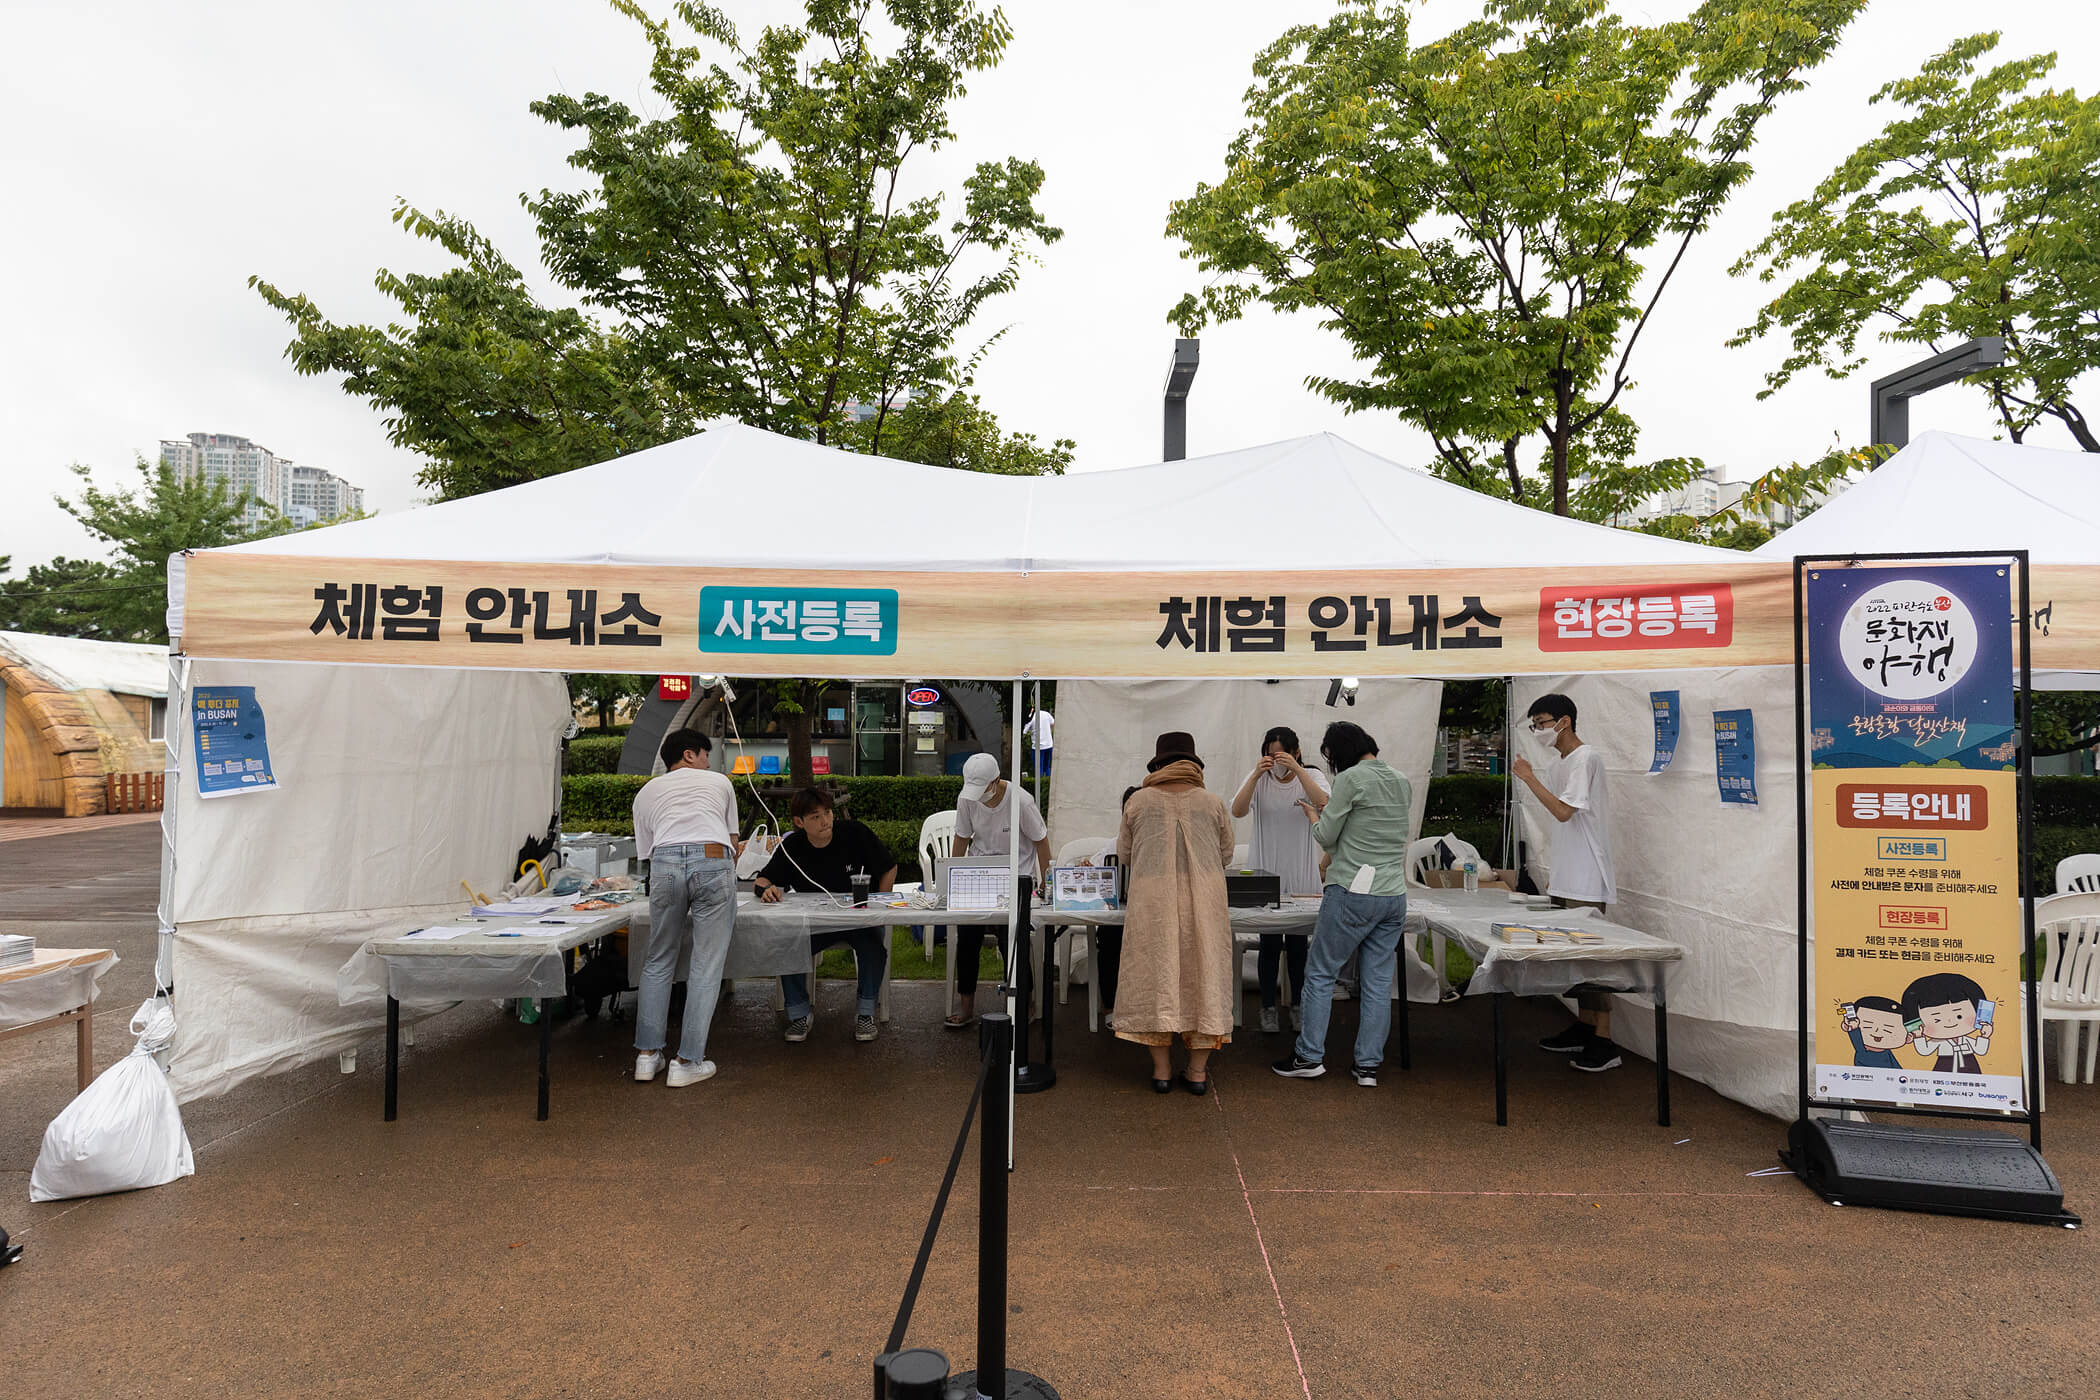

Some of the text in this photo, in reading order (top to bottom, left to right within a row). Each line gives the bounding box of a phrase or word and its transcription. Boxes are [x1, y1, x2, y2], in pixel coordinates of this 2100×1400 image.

[310, 583, 662, 646] 체험 안내소
[714, 599, 883, 642] 사전등록
[1554, 595, 1719, 639] 현장등록
[1156, 595, 1503, 653] 체험 안내소
[1866, 617, 1949, 644] 문화재
[1863, 637, 1954, 687] 야행
[909, 691, 937, 702] OPEN
[208, 709, 237, 719] BUSAN
[1851, 792, 1971, 822] 등록안내
[1886, 842, 1938, 856] 사전등록
[1864, 868, 1961, 879] 체험 쿠폰 수령을 위해
[1831, 880, 1998, 894] 사전에 안내받은 문자를 준비해주세요
[1887, 911, 1939, 925] 현장등록
[1865, 936, 1963, 949] 체험 쿠폰 수령을 위해
[1836, 948, 1996, 964] 결제 카드 또는 현금을 준비해주세요
